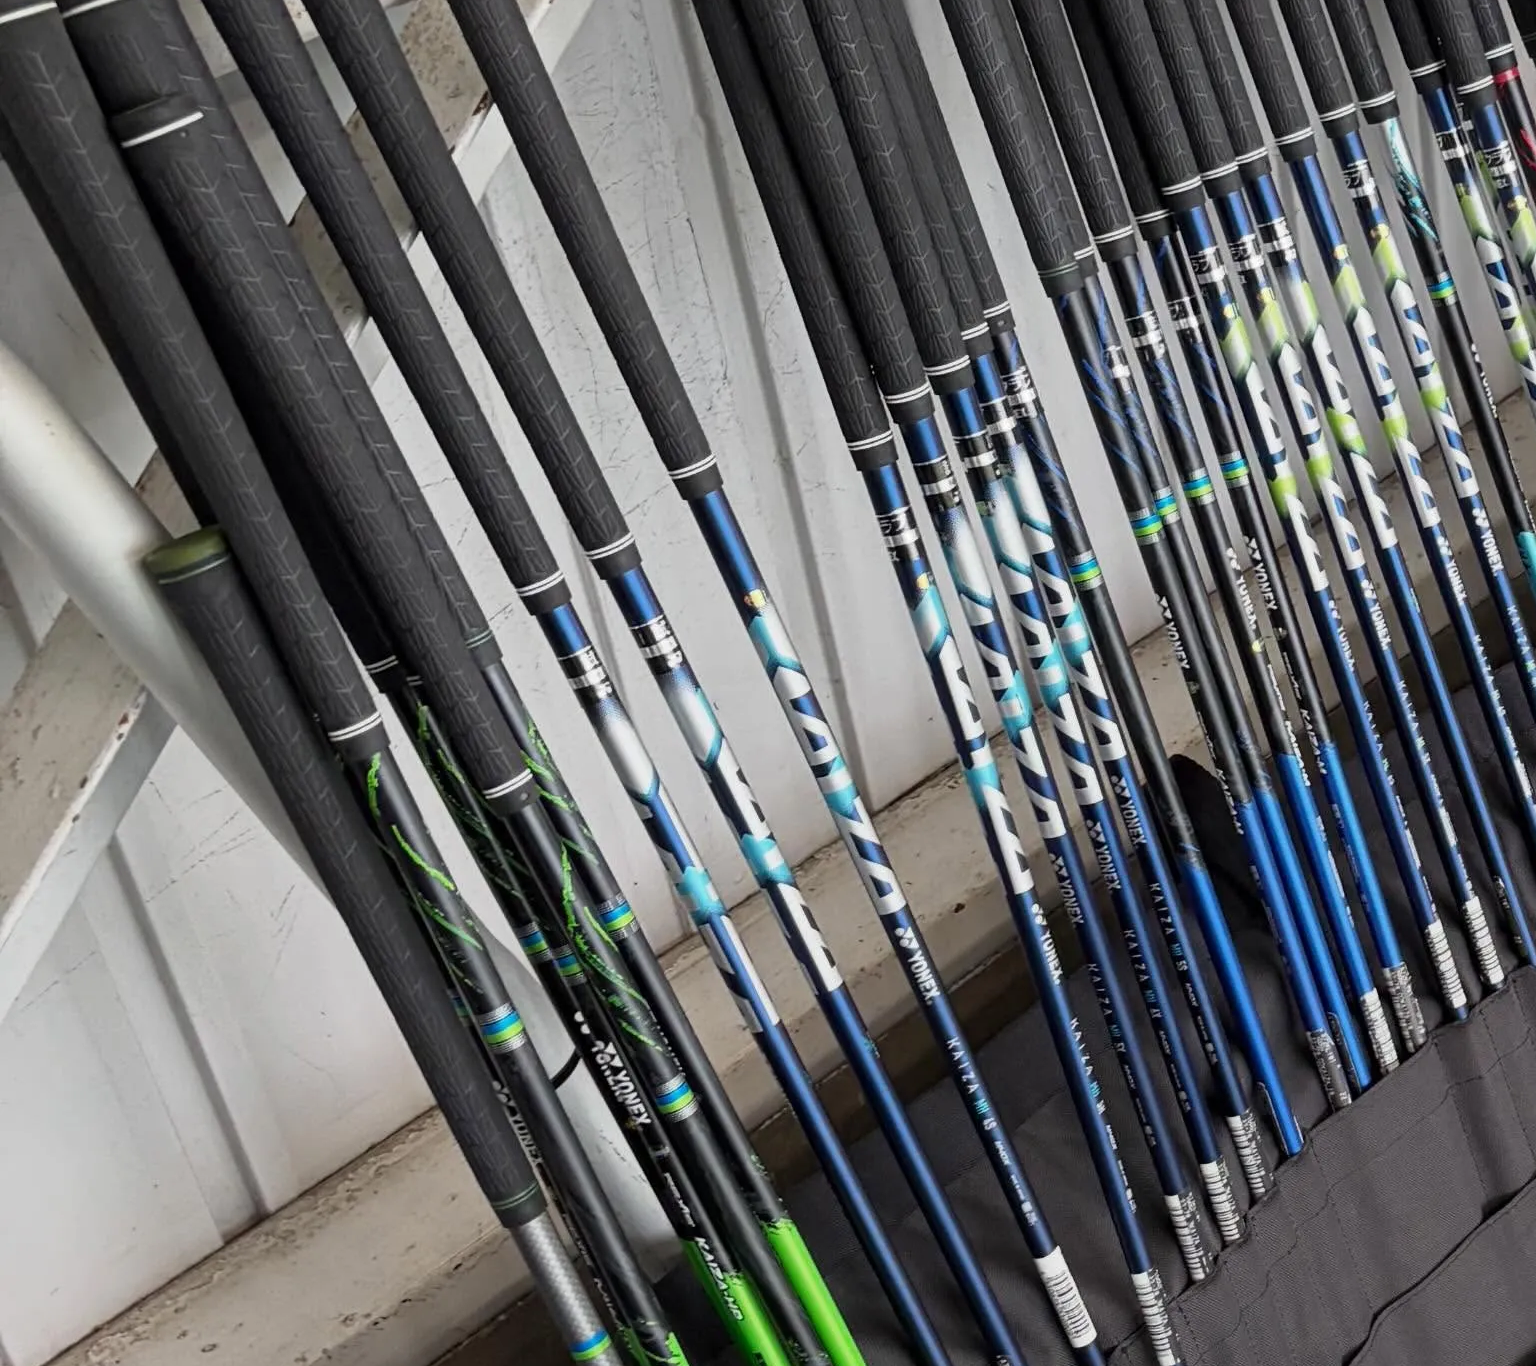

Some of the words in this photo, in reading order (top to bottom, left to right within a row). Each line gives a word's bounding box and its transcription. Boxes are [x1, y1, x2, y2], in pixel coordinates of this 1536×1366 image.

[1252, 561, 1278, 613] YONEX
[1442, 558, 1468, 603] YONEX
[1478, 529, 1503, 574] YONEX
[1504, 604, 1531, 655] KAIZA
[1163, 620, 1188, 671] YONEX
[1367, 601, 1391, 647] YONEX
[1118, 797, 1147, 846] YONEX
[1147, 880, 1176, 937] KAIZA
[1056, 877, 1083, 926] YONEX
[1093, 842, 1122, 892] YONEX
[1121, 927, 1147, 983] KAIZA
[904, 948, 942, 1001] YONEX
[944, 1036, 982, 1094] KAIZA
[612, 1068, 651, 1128] YONEX
